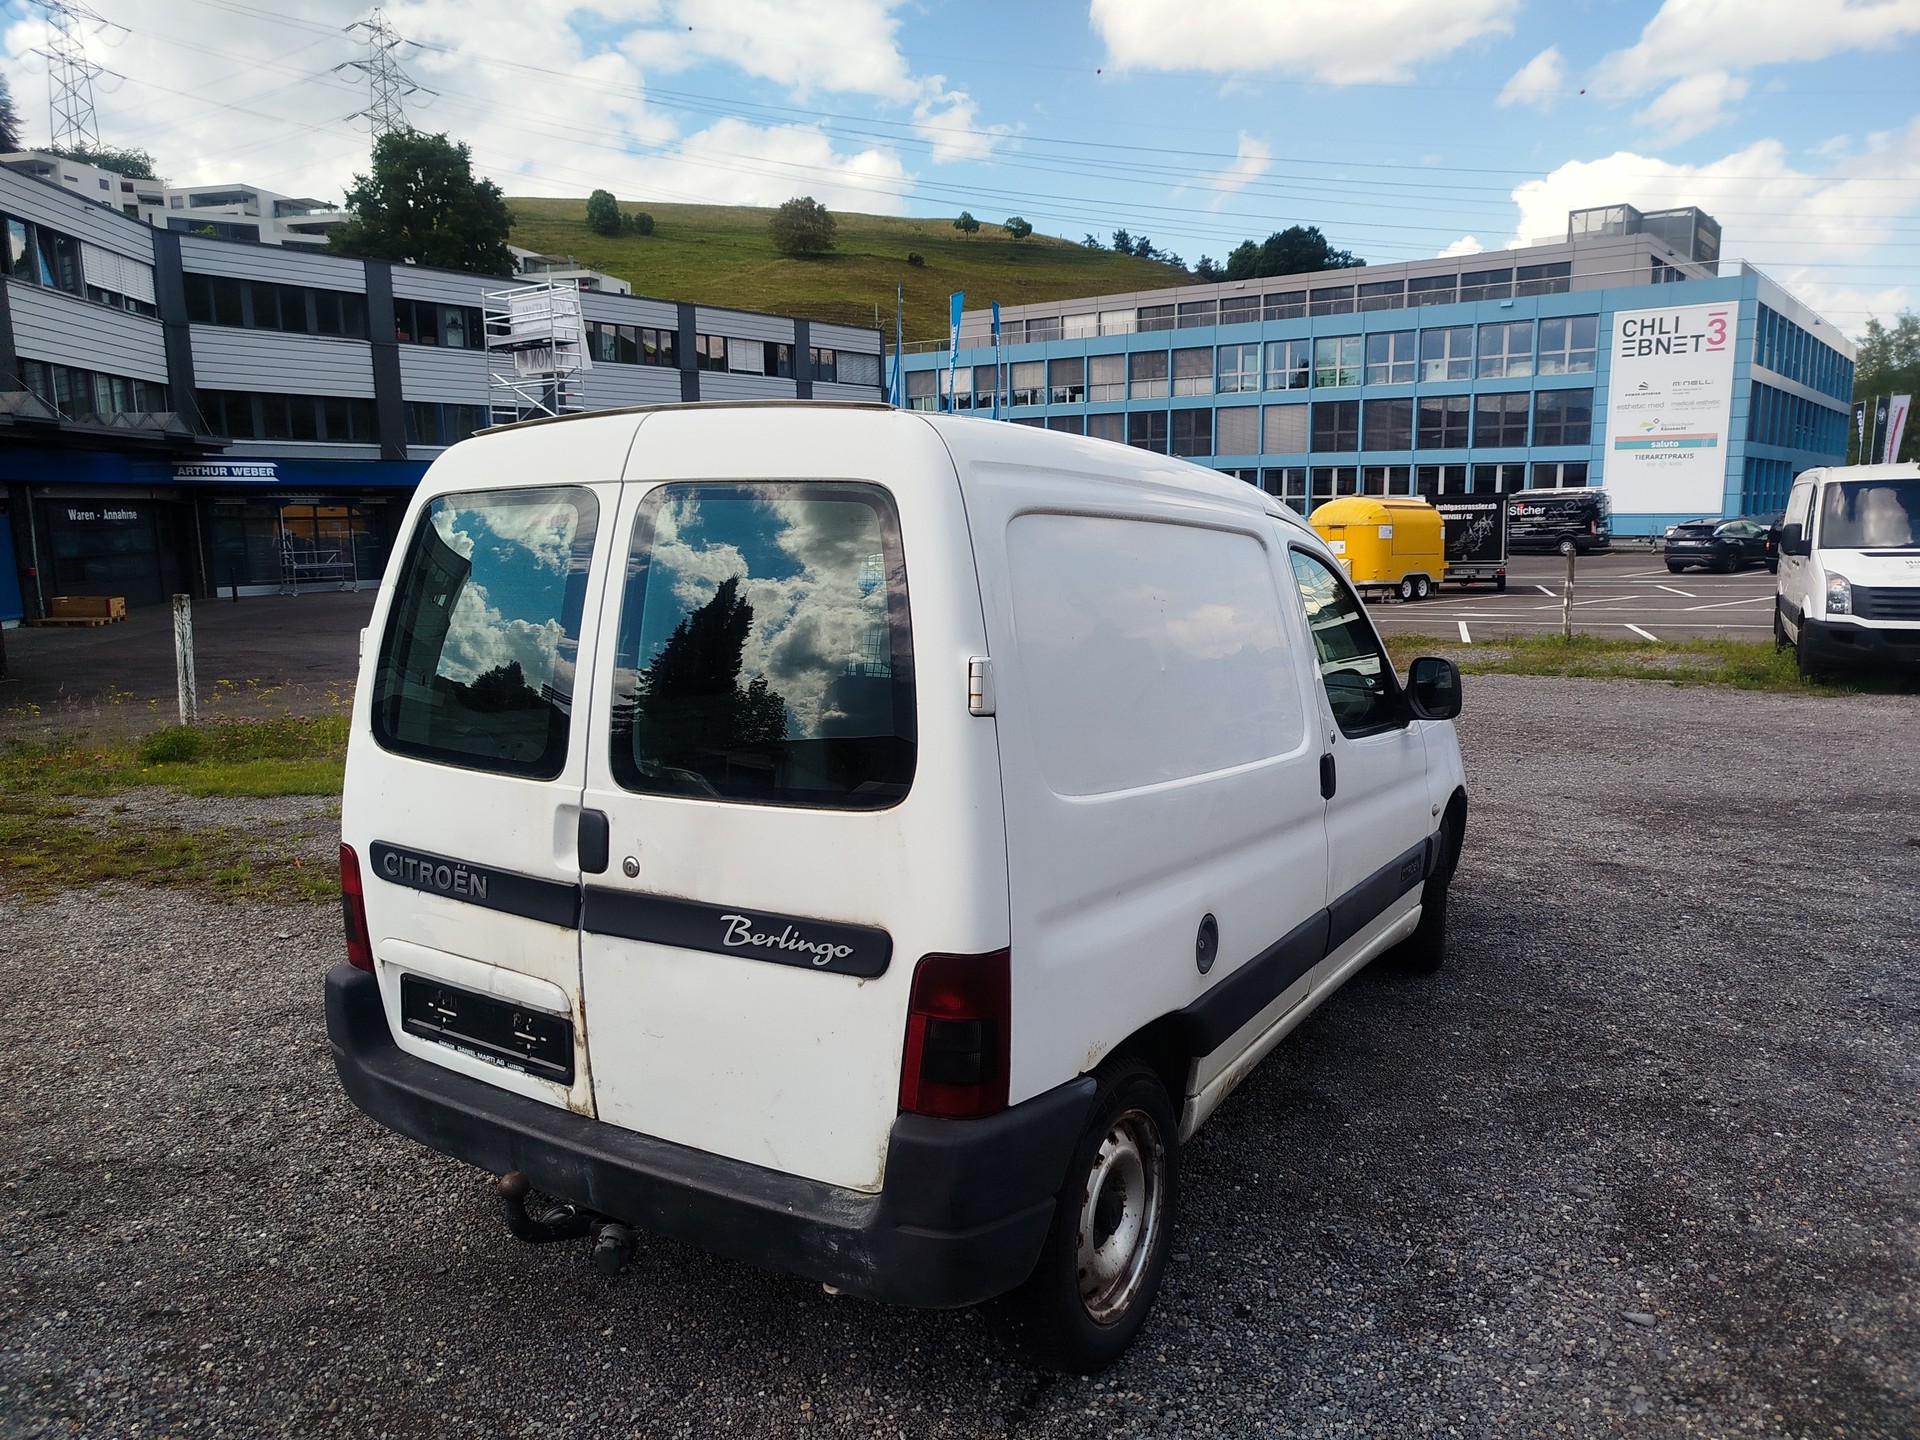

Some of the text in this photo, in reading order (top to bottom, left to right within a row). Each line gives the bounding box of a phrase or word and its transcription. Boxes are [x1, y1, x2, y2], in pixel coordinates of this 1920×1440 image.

[1622, 316, 1680, 338] CHLI
[1706, 318, 1727, 345] 3
[1621, 334, 1705, 357] EBNET
[1616, 403, 1646, 411] esthetic
[1647, 401, 1665, 409] med
[1651, 440, 1679, 449] saluto
[1635, 453, 1695, 461] TIERARZTPRAXIS
[177, 466, 275, 477] ARTHUR WEBER
[68, 509, 95, 521] Waren
[103, 509, 138, 521] Annahme
[1509, 505, 1546, 516] Sticher
[383, 852, 488, 899] CITROËN
[720, 914, 853, 966] Berlingo
[457, 1045, 477, 1057] DANIEL
